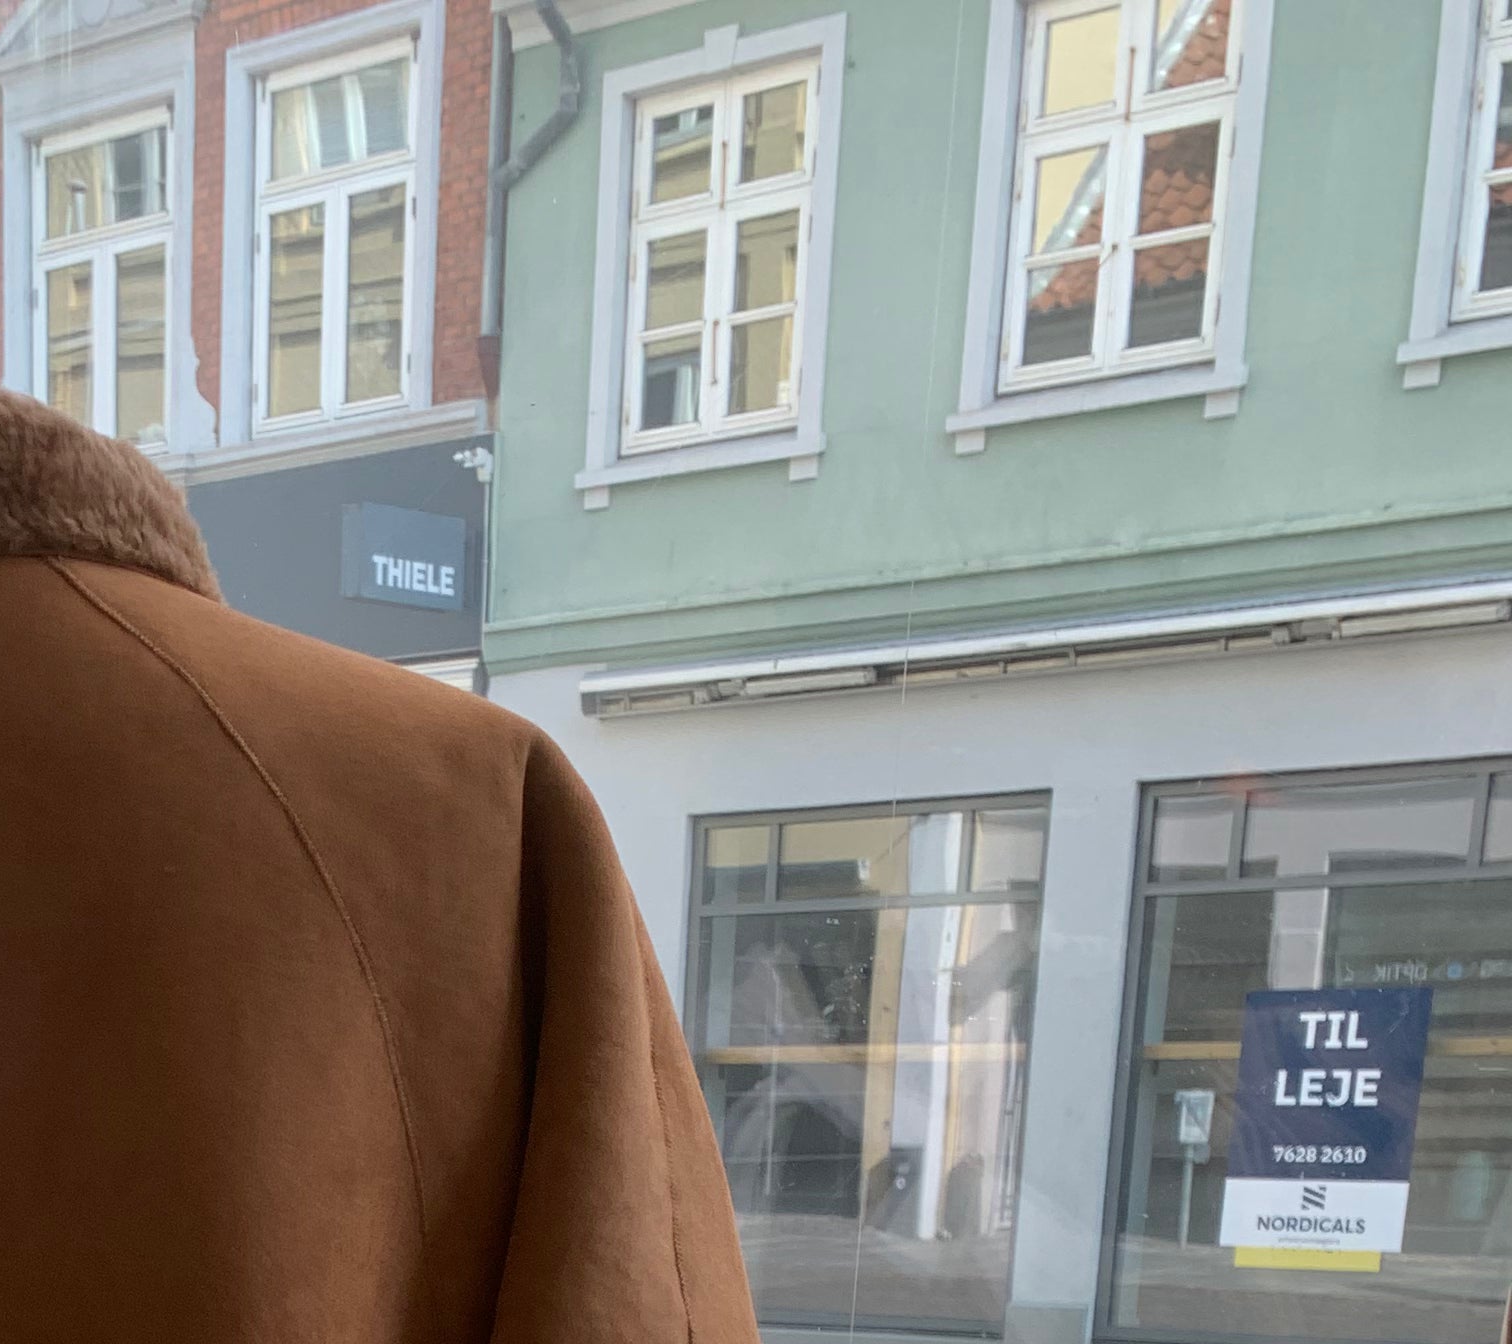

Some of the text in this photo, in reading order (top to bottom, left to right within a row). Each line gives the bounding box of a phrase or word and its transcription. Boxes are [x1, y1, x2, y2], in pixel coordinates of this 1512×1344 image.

[373, 555, 455, 596] THIELE
[1299, 1011, 1369, 1050] TIL
[1274, 1069, 1382, 1107] LEJE
[1273, 1145, 1367, 1164] 7628 2610
[1257, 1216, 1366, 1235] NORDICALS
